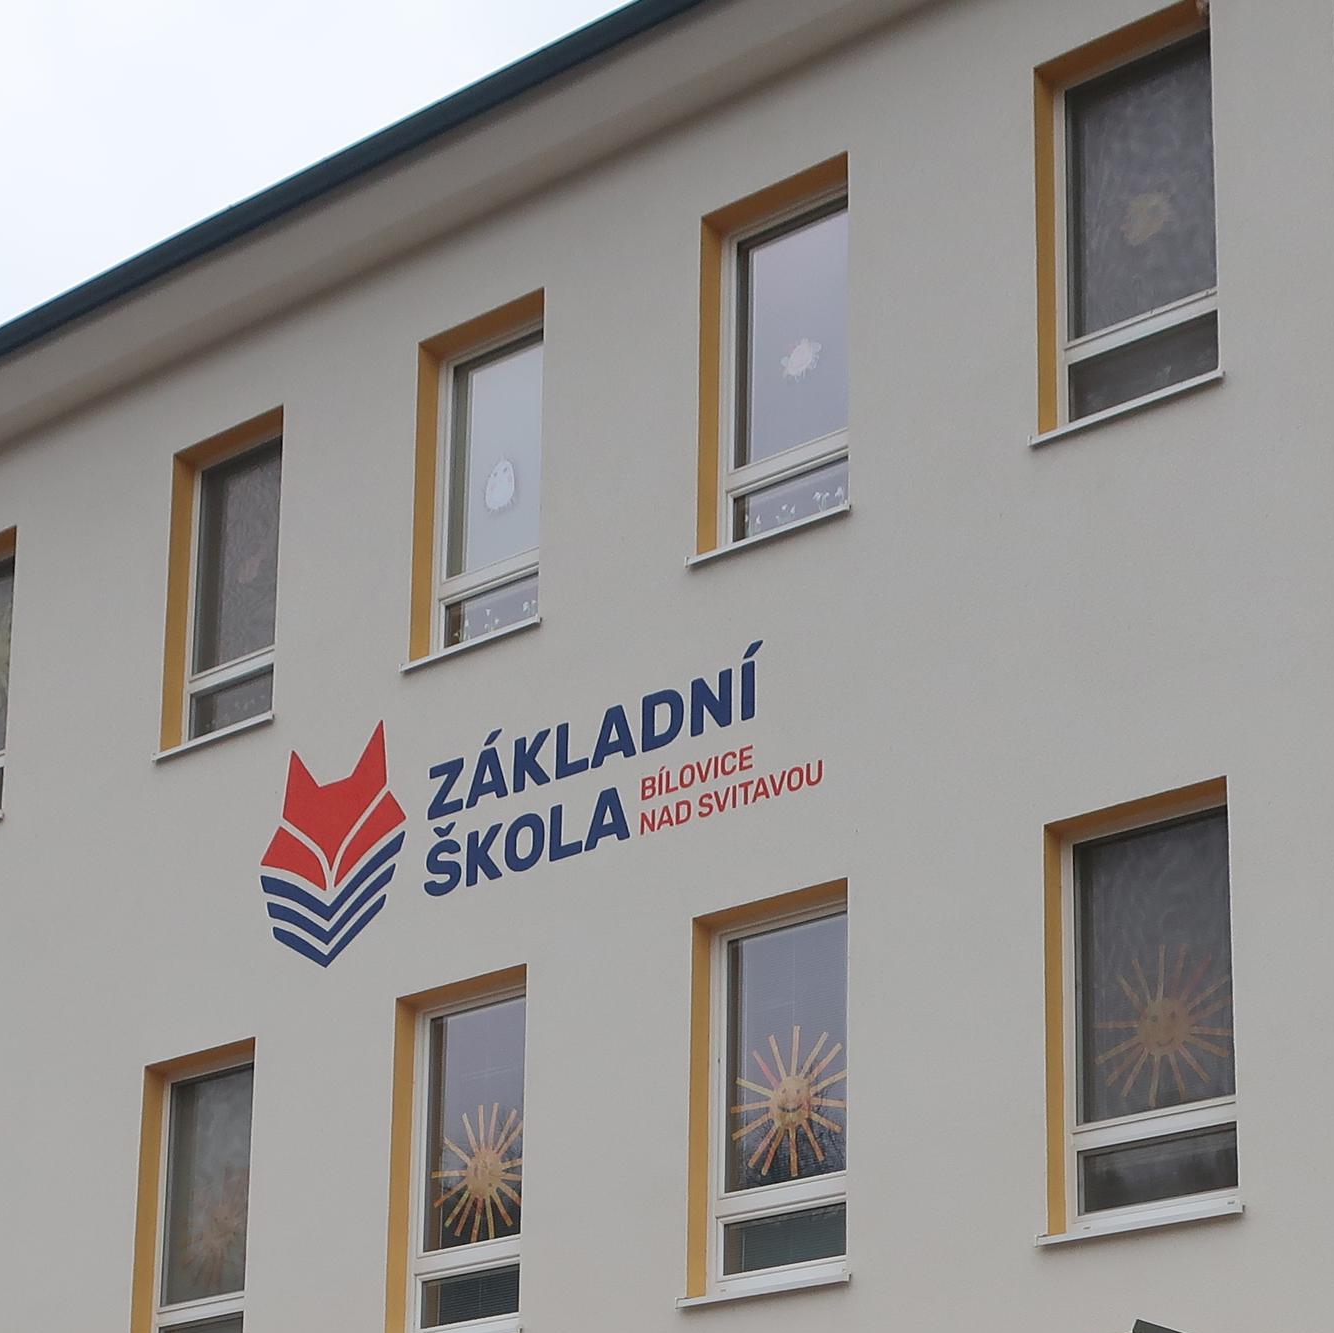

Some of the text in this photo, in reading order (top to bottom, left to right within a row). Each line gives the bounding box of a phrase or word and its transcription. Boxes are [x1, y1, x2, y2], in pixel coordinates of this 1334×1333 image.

[427, 640, 763, 820] ZÁKLADNÍ
[640, 744, 755, 801] BÍLOVICE
[423, 786, 631, 897] ŠKOLA
[639, 759, 825, 836] NAD SVITAVOU
